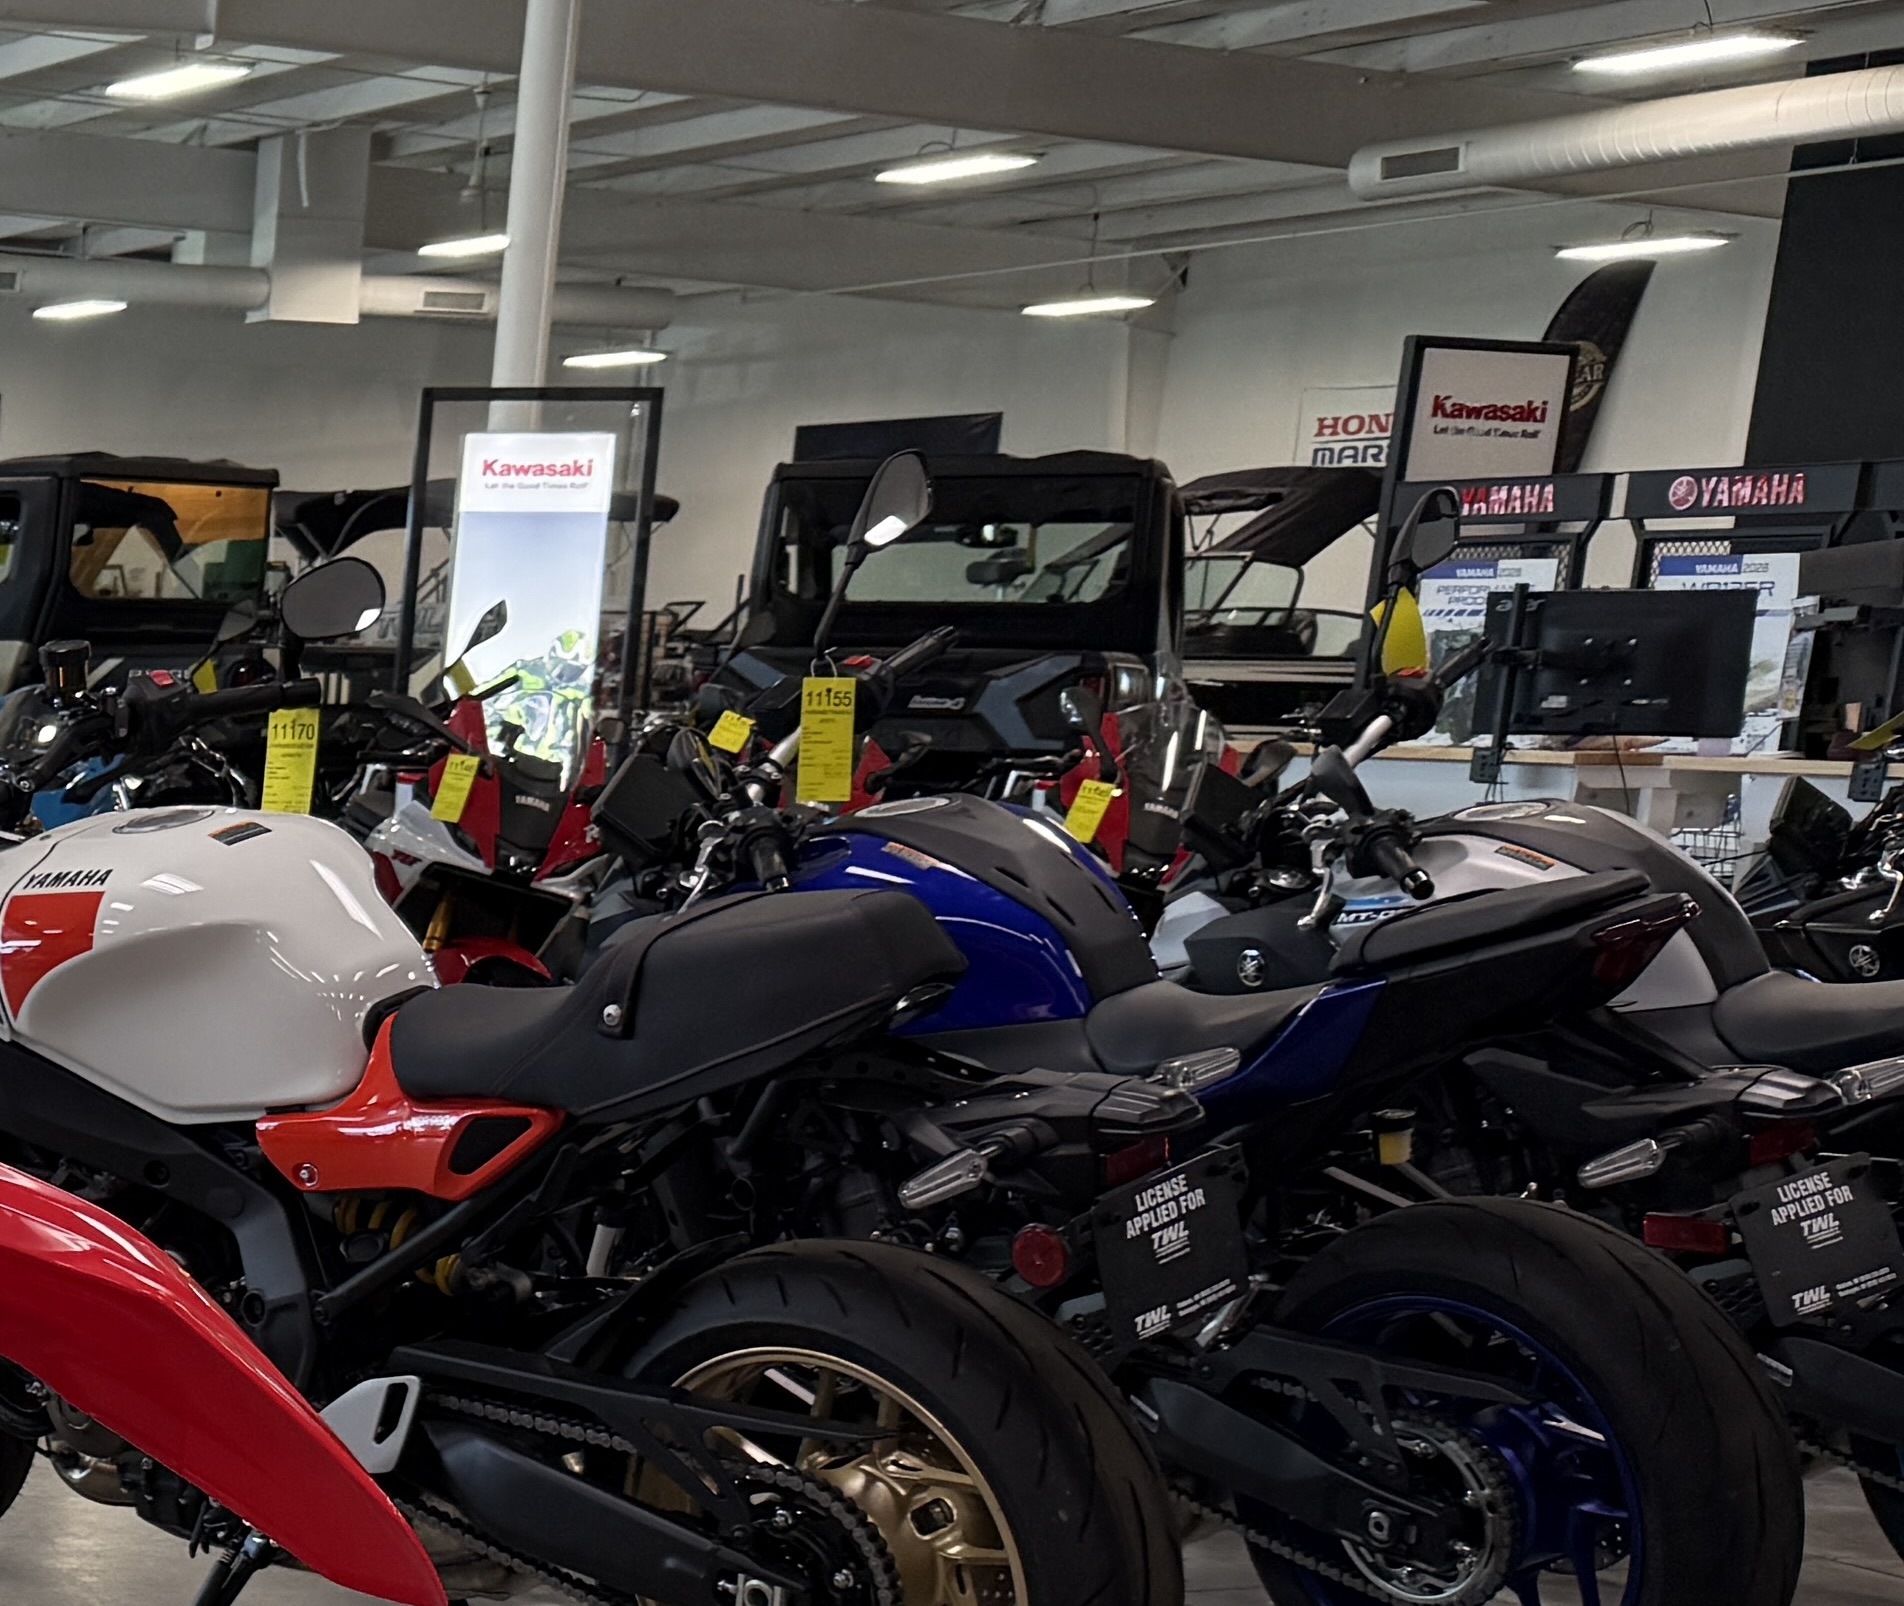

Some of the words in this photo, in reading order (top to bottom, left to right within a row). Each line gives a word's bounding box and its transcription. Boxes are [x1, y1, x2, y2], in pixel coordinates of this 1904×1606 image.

[1430, 395, 1550, 424] Kawasaki
[1314, 413, 1392, 438] HON
[1312, 440, 1391, 467] MAR
[482, 459, 594, 477] Kawasaki
[1462, 484, 1554, 516] YAMAHA
[1701, 473, 1807, 507] YAMAHA
[1695, 562, 1740, 574] YAMAHA
[806, 689, 853, 707] 11155
[271, 722, 316, 741] 11170
[23, 868, 114, 890] YAMAHA
[1336, 908, 1405, 923] MT-0
[1134, 1173, 1189, 1212] LICENSE
[1777, 1171, 1833, 1203] LICENSE
[1126, 1200, 1178, 1239] APPLIED
[1179, 1188, 1206, 1214] FOR
[1771, 1194, 1826, 1226] APPLIED
[1825, 1185, 1854, 1207] FOR
